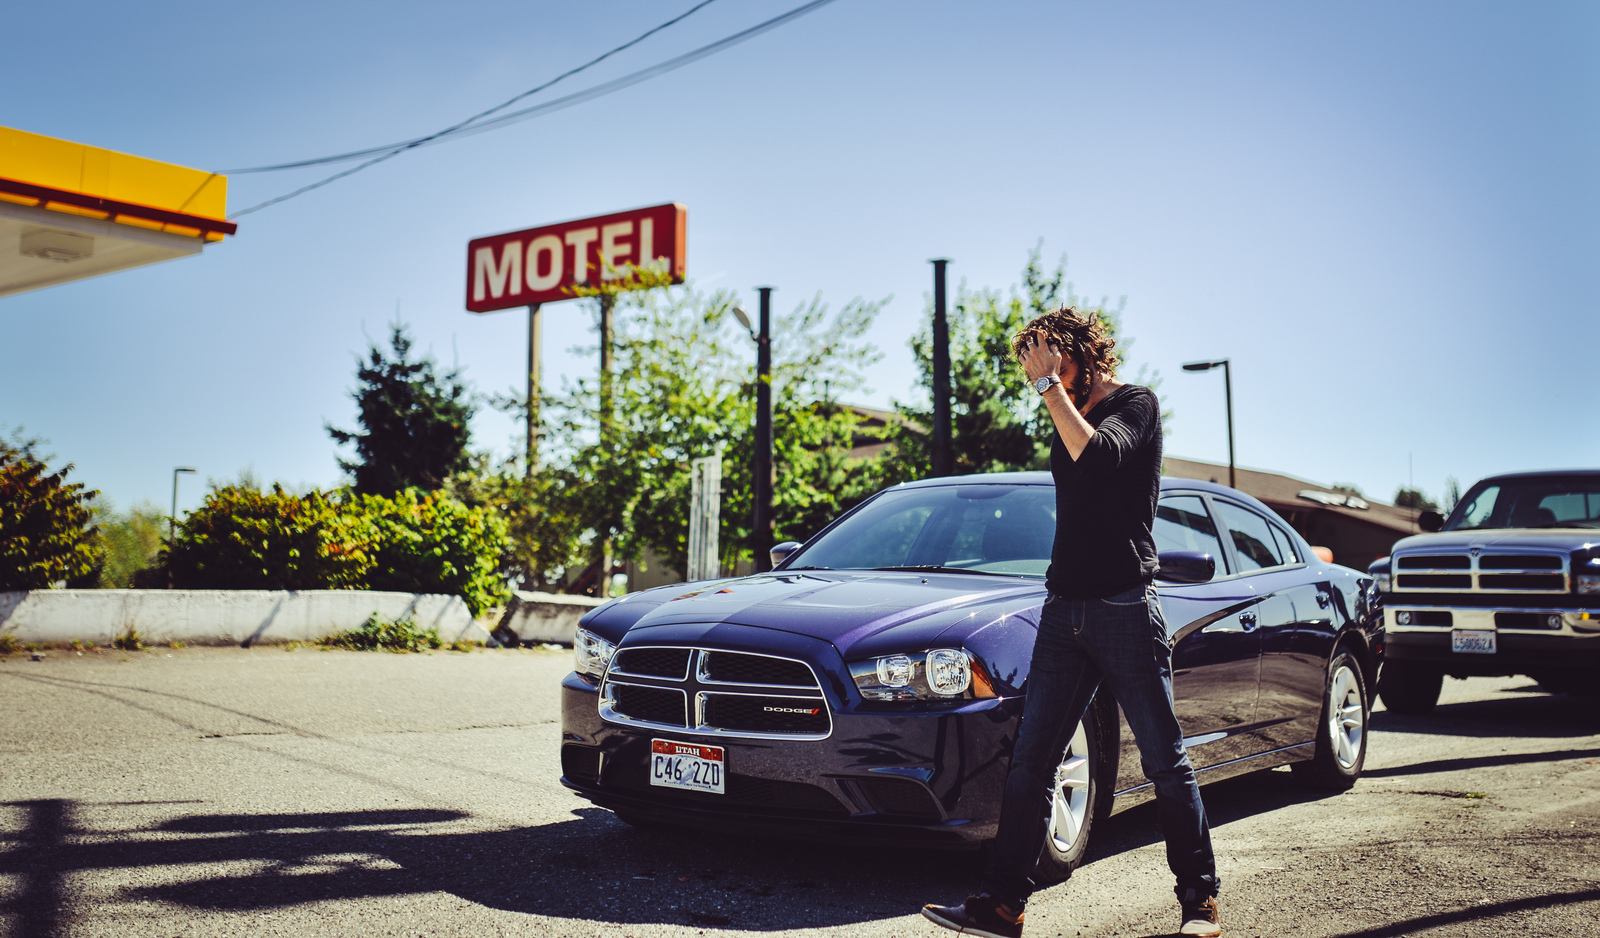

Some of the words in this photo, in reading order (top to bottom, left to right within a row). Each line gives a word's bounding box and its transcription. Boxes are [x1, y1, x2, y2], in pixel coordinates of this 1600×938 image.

[473, 216, 671, 302] MOTEL
[763, 706, 813, 714] DODGE
[675, 745, 700, 757] UTAH
[655, 756, 682, 780] C46
[693, 761, 720, 786] 2ZD
